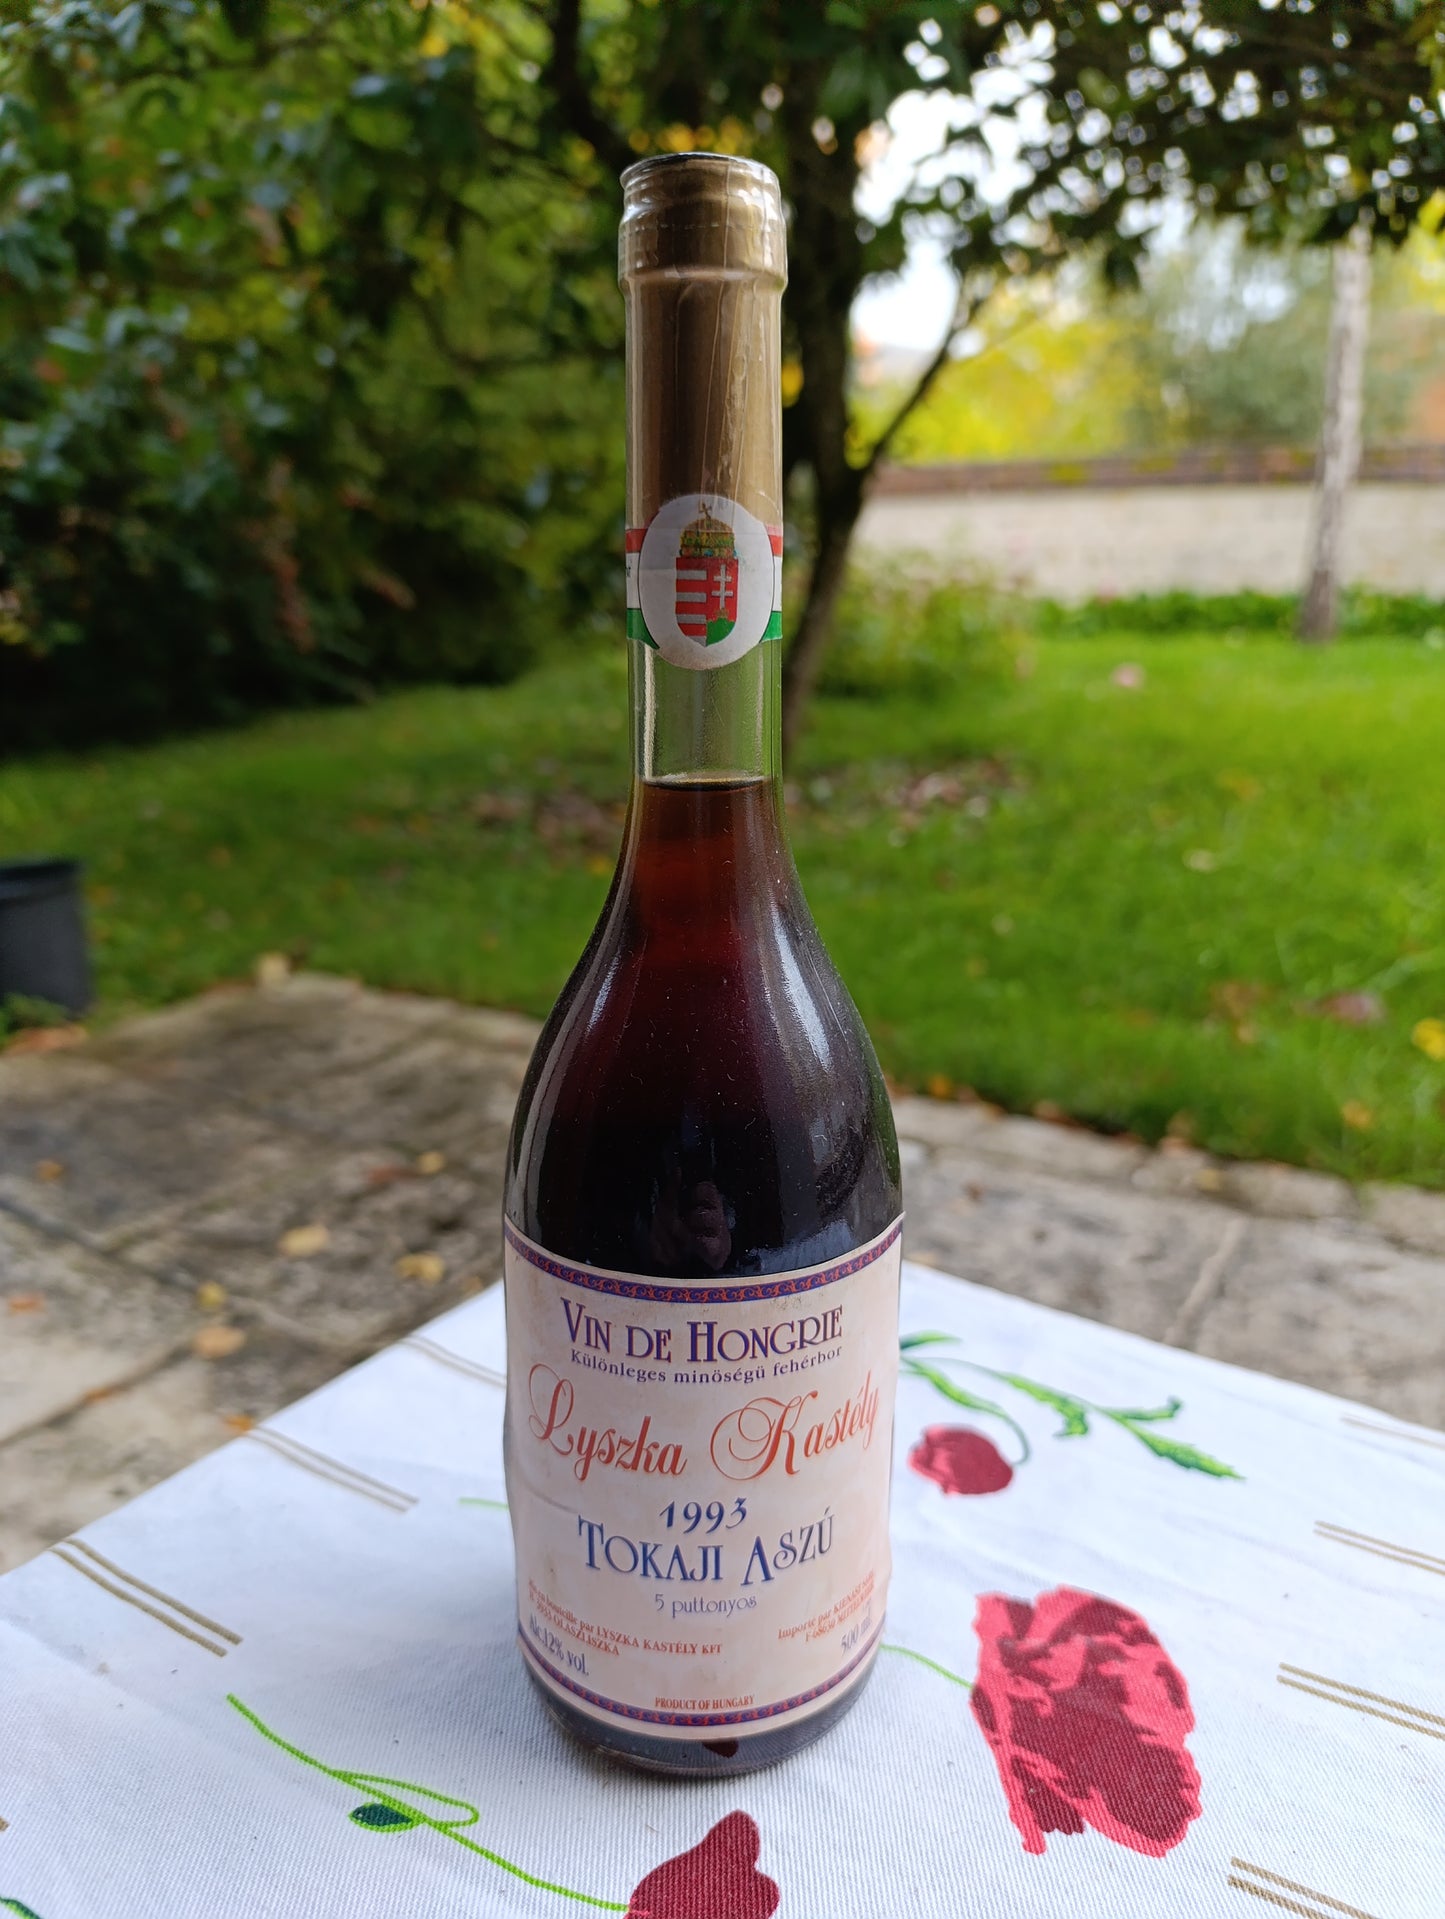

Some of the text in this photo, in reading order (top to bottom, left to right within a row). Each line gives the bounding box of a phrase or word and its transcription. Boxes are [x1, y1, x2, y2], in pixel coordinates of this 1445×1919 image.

[561, 1296, 843, 1363] VIN DE HONGRIE
[571, 1345, 843, 1384] Különleges minöségü fehérbor
[528, 1362, 880, 1482] Lyszka Kastély
[658, 1496, 748, 1535] 1993
[577, 1505, 836, 1586] TOKAJI ASZÚ
[654, 1593, 758, 1619] 5 puttonyos
[579, 1620, 594, 1634] par
[596, 1624, 641, 1649] LYSZKA
[643, 1638, 699, 1656] KASTÉLY
[840, 1622, 859, 1656] 500
[654, 1694, 756, 1711] PRODUCT OF HUNGARY
